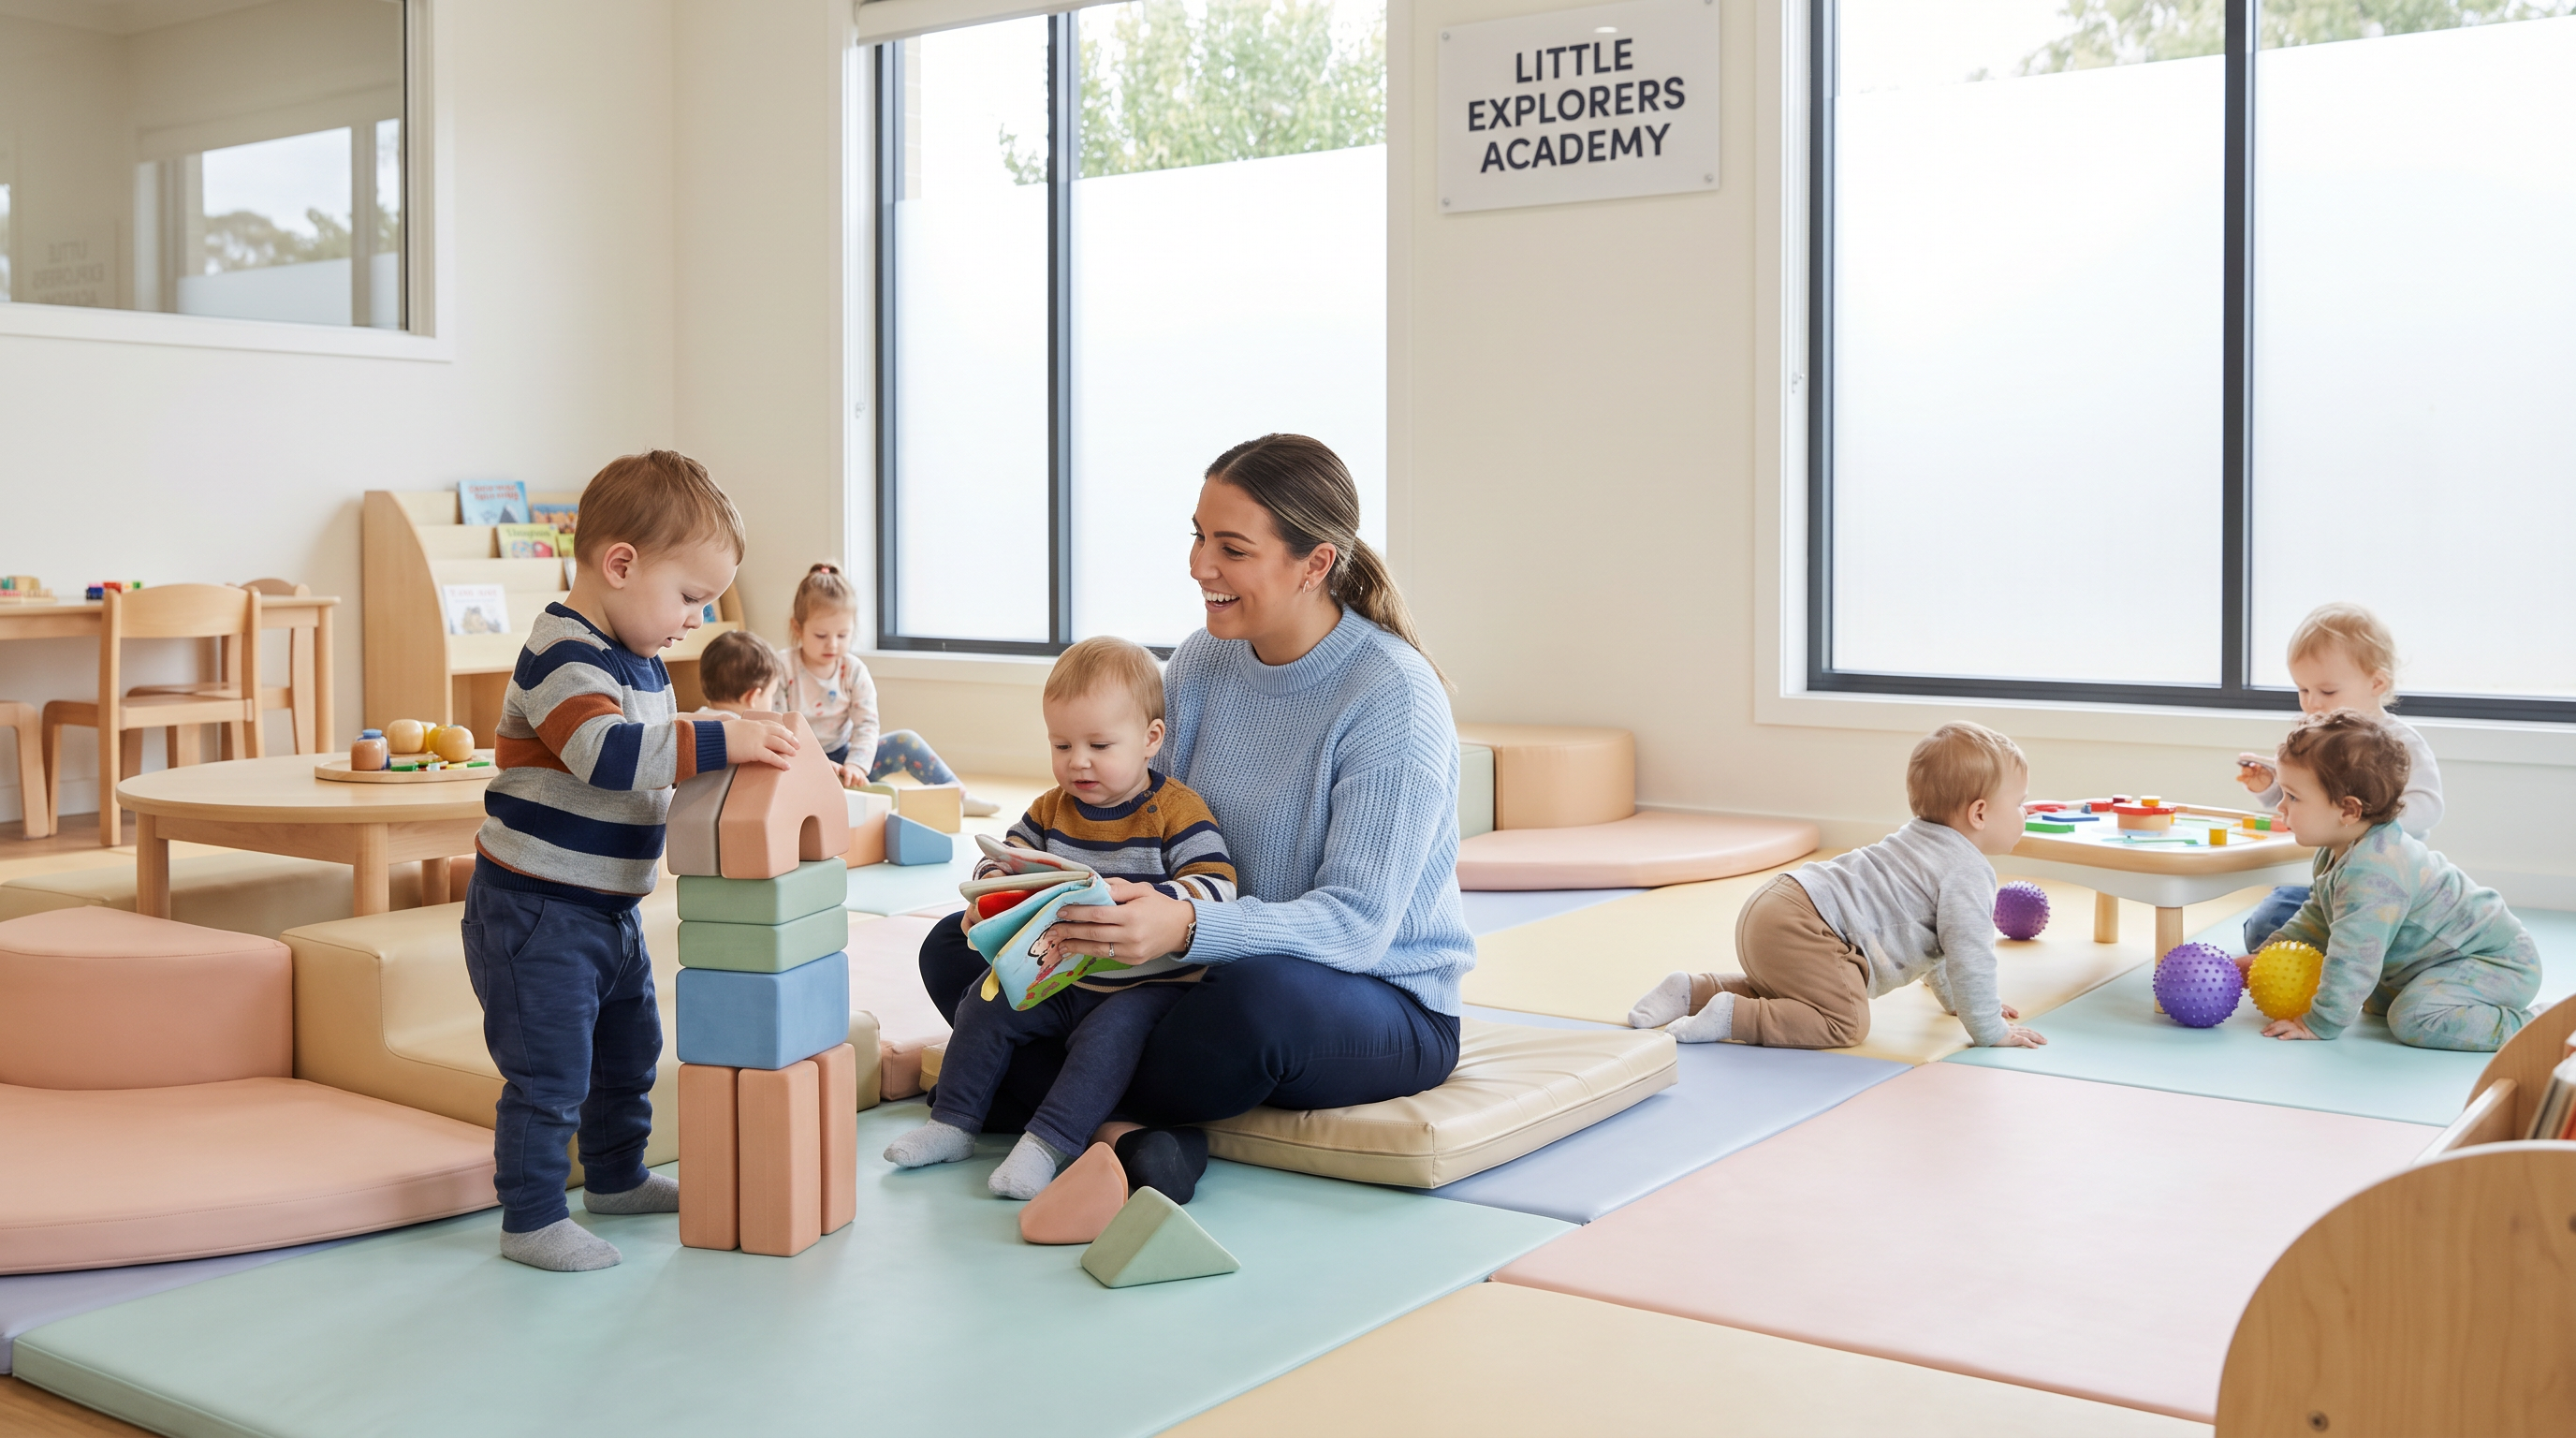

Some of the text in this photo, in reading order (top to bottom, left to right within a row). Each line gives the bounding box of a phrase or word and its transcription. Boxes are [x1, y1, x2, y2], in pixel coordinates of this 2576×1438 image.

[1515, 37, 1633, 84] LITTLE
[1468, 76, 1686, 132] EXPLORERS
[1480, 123, 1671, 174] ACADEMY
